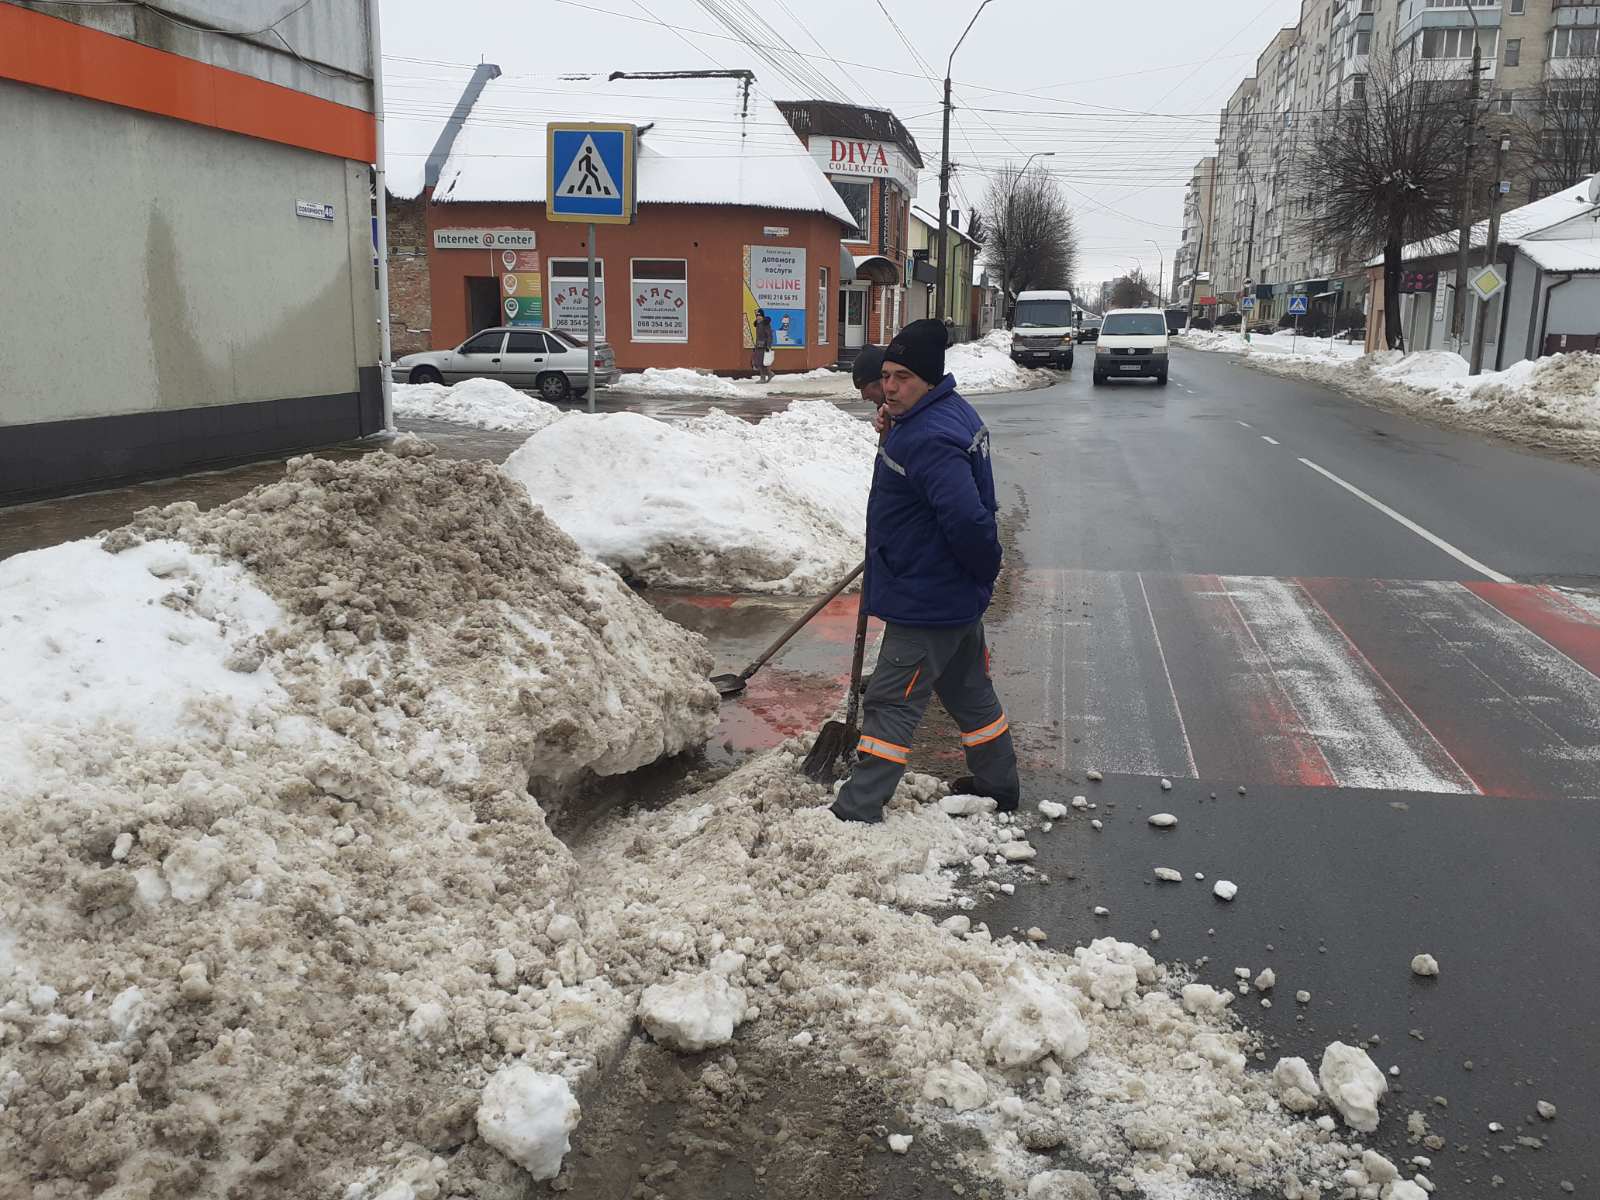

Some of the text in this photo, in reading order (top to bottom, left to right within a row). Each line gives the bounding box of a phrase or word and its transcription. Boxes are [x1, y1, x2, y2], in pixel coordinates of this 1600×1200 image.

[831, 139, 888, 166] DIVA
[828, 163, 889, 174] COLLECTION
[437, 233, 533, 247] Internet @ Center
[755, 279, 801, 291] ONLINE
